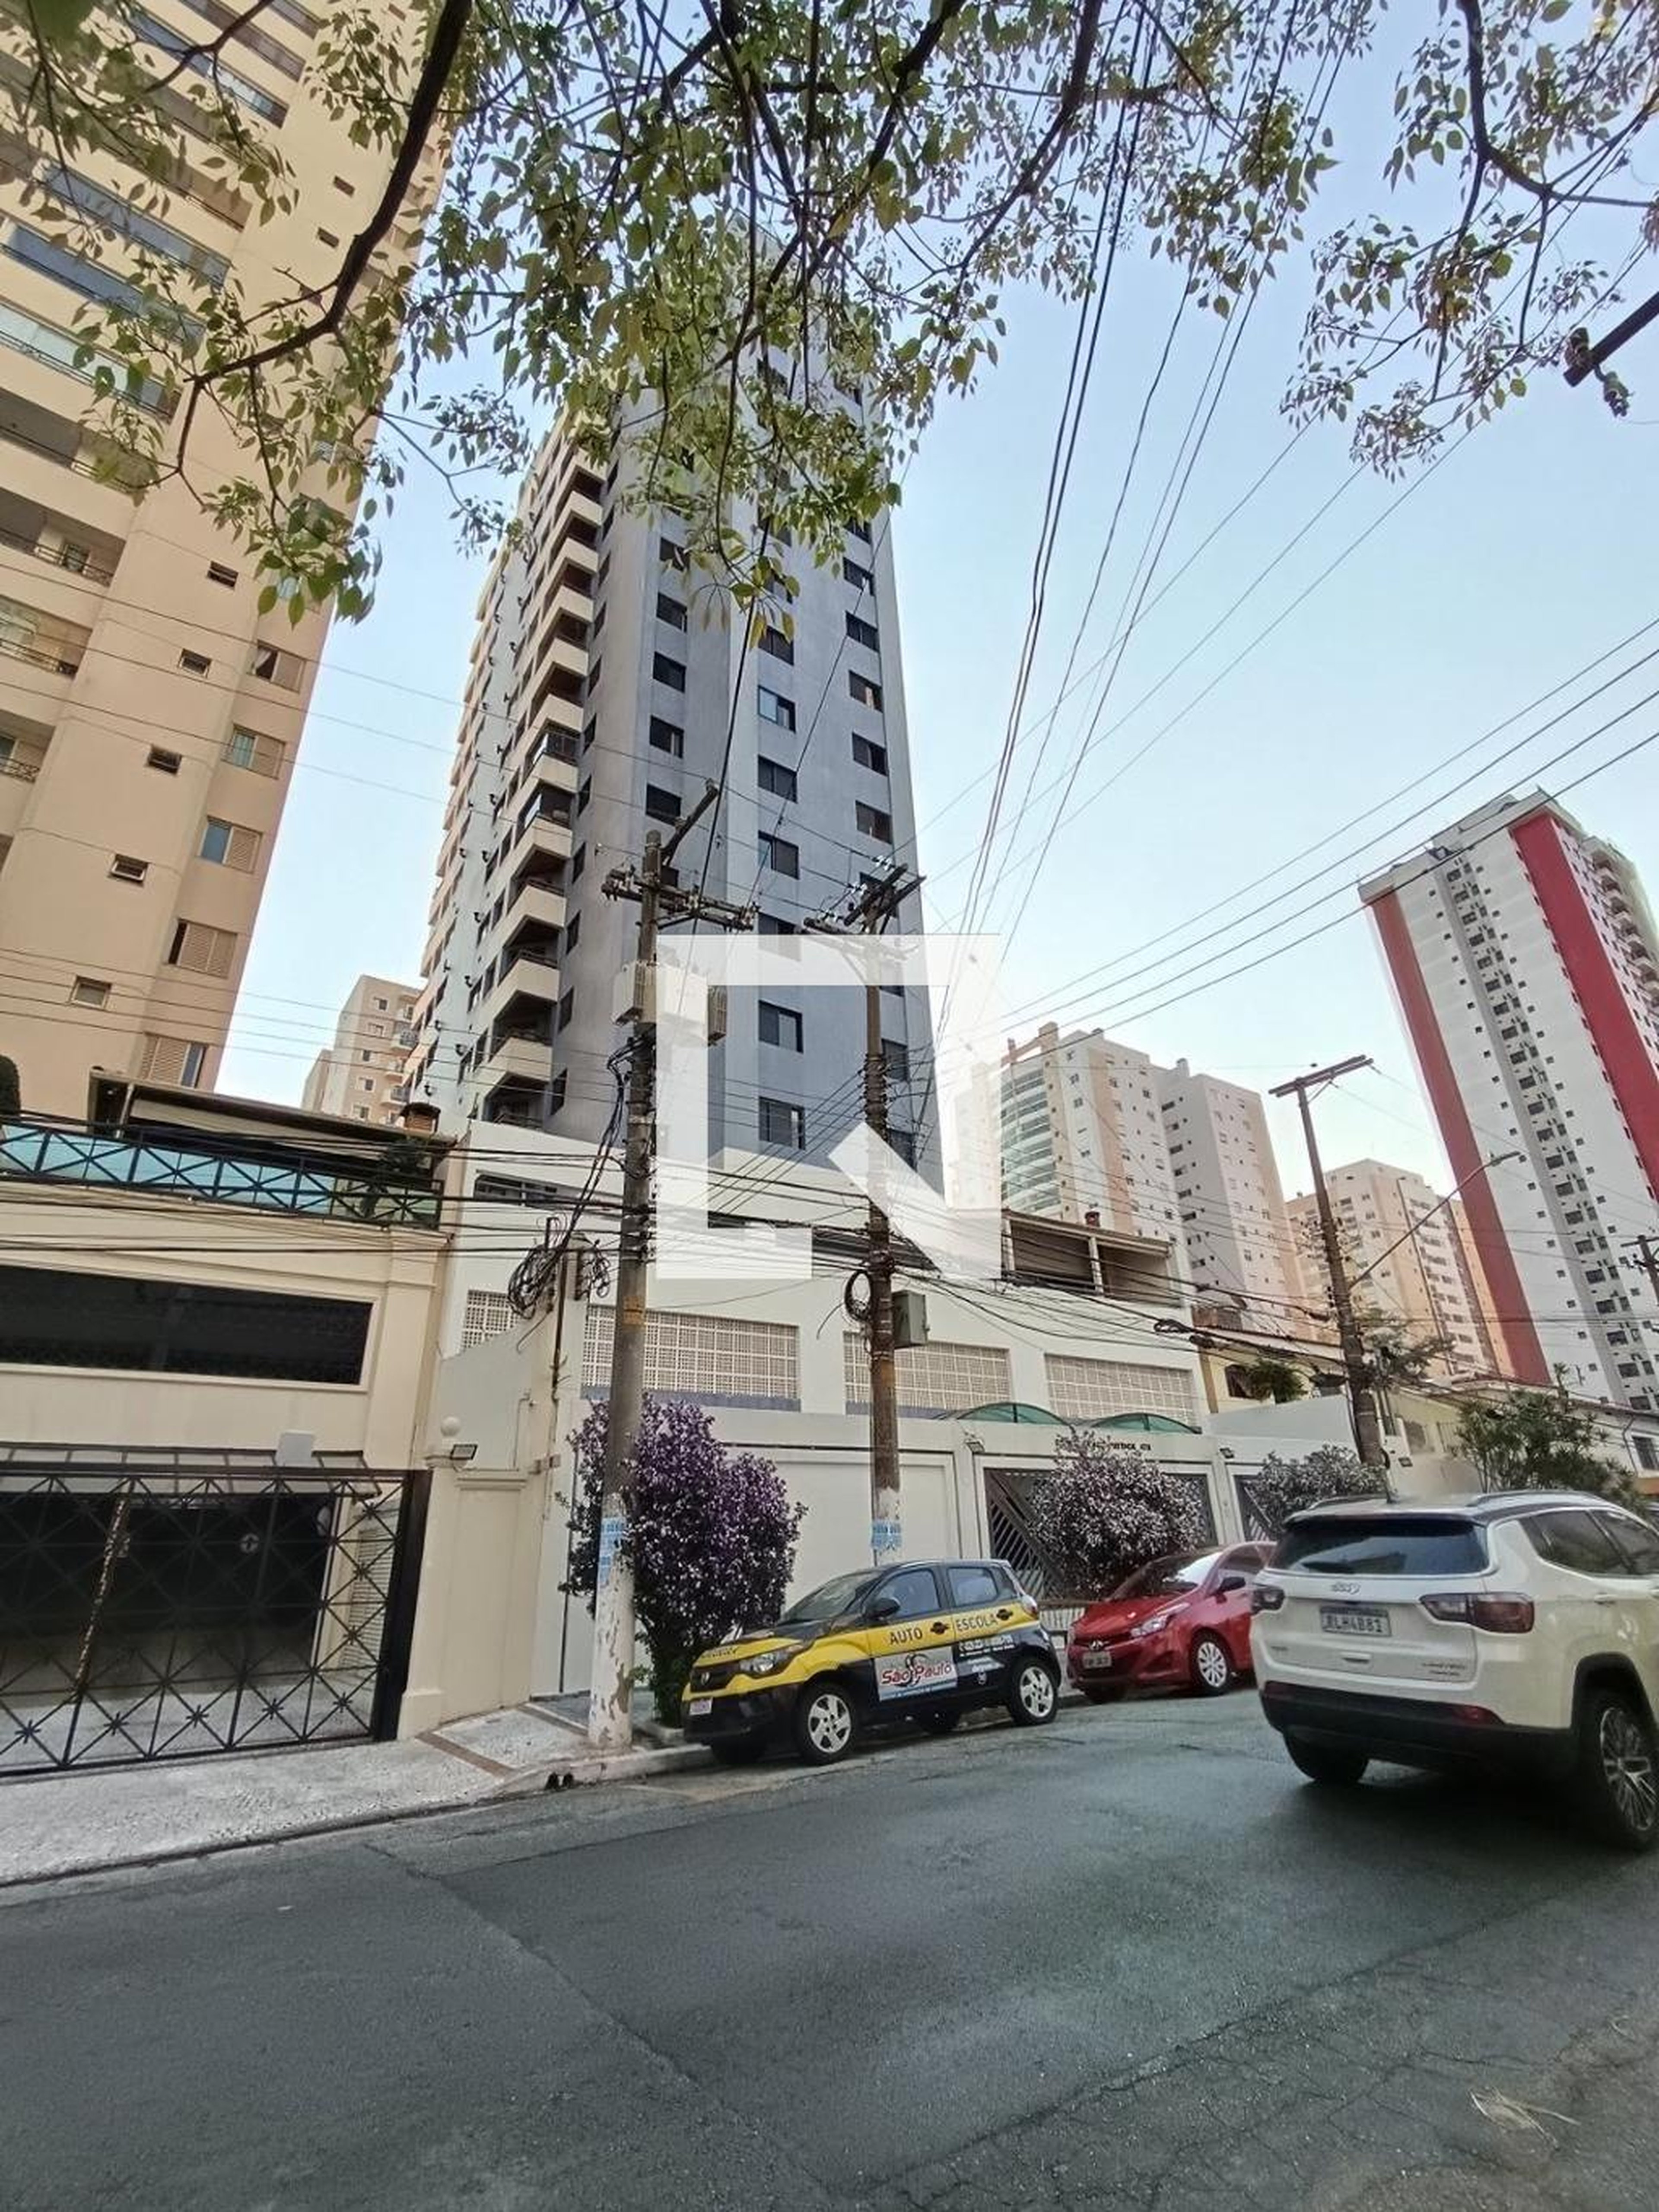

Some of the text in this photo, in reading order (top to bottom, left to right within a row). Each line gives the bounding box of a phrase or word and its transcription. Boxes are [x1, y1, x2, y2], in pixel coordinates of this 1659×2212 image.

[890, 1614, 997, 1645] AUTO ESCOLA
[915, 1662, 951, 1678] Paulo
